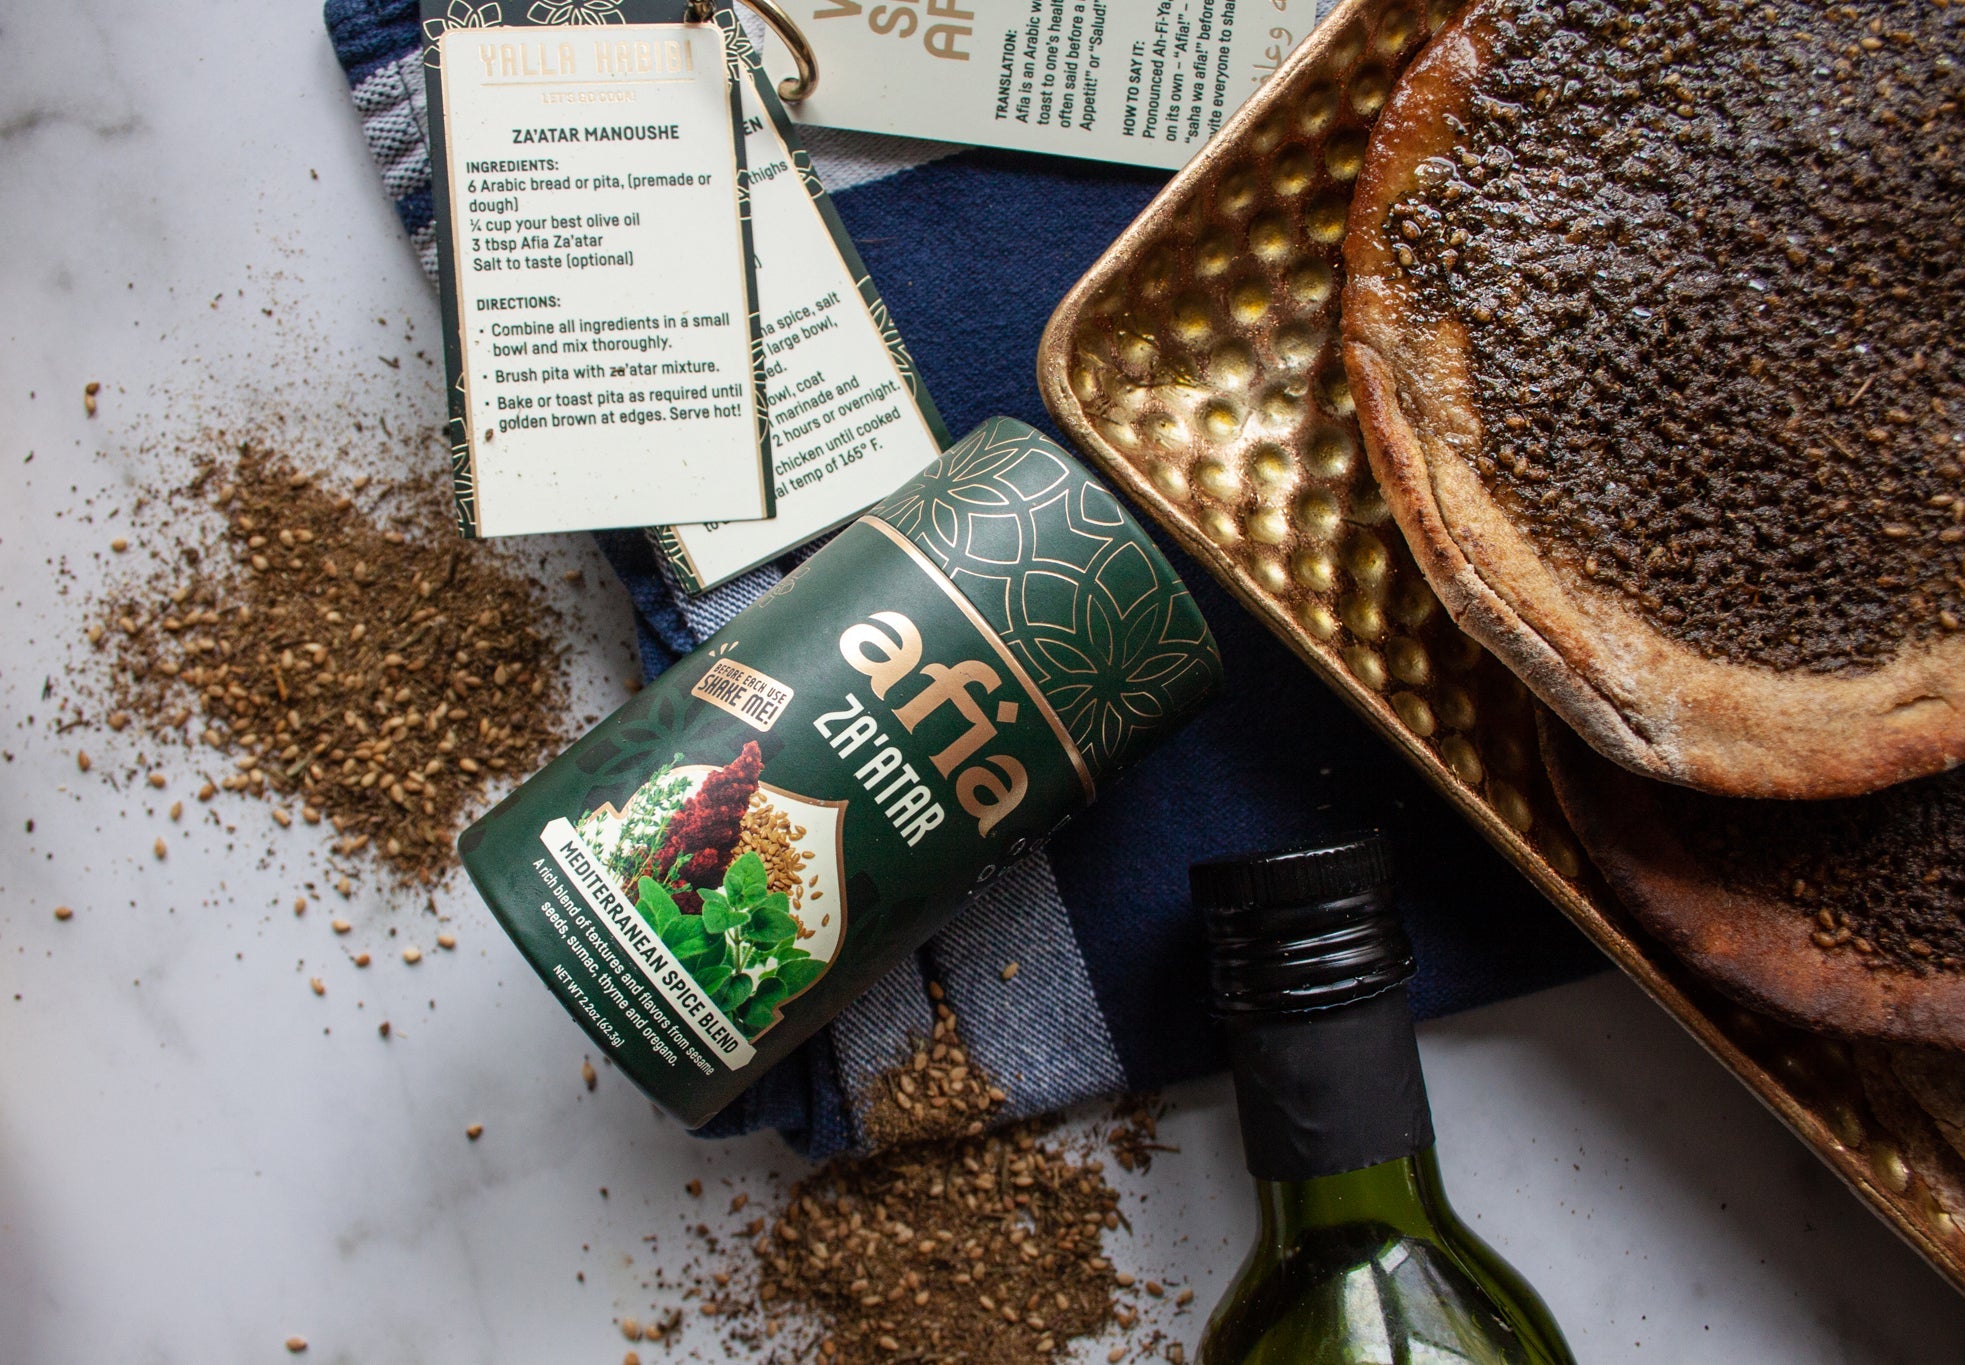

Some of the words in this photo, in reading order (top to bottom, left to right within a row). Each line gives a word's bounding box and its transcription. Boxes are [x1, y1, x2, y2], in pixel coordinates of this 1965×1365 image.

[1074, 5, 1085, 13] a
[1023, 16, 1041, 60] Arabic
[1065, 16, 1084, 59] before
[1132, 40, 1145, 57] IT:
[1218, 29, 1233, 43] to
[478, 42, 576, 77] YALLA
[593, 39, 695, 75] HABIBI
[1045, 35, 1060, 71] one's
[1088, 54, 1100, 69] or
[995, 29, 1017, 120] TRANSLATION:
[1023, 62, 1035, 79] an
[1041, 73, 1055, 88] to
[1063, 61, 1078, 90] said
[1128, 58, 1143, 84] SAY
[1212, 44, 1230, 107] everyone
[1018, 81, 1033, 94] is
[1126, 86, 1140, 102] TO
[1142, 59, 1164, 139] Pronounced
[1170, 73, 1184, 102] own
[1192, 82, 1205, 102] wa
[1015, 96, 1031, 124] Afia
[1036, 90, 1053, 125] toast
[1058, 93, 1075, 128] often
[1122, 104, 1137, 136] HOW
[1165, 105, 1181, 122] its
[512, 127, 580, 144] ZA'ATAR
[584, 125, 680, 142] MANOUSHE
[1166, 125, 1178, 142] on
[466, 158, 559, 174] INGREDIENTS:
[467, 179, 477, 194] 6
[480, 177, 527, 193] Arabic
[530, 176, 571, 191] bread
[575, 178, 589, 190] or
[593, 175, 625, 191] pita,
[698, 174, 712, 186] or
[485, 220, 512, 234] cup
[515, 218, 547, 233] your
[550, 215, 583, 229] best
[586, 213, 620, 228] olive
[623, 212, 640, 227] oil
[472, 238, 481, 252] 3
[485, 237, 517, 253] tbsp
[521, 235, 549, 250] Afia
[553, 234, 604, 249] Za'atar
[473, 257, 502, 272] Salt
[505, 257, 521, 270] to
[524, 255, 562, 270] taste
[476, 295, 561, 311] DIRECTIONS:
[776, 307, 816, 330] spice,
[815, 292, 841, 312] salt
[491, 321, 555, 337] Combine
[559, 319, 576, 334] all
[579, 316, 660, 335] ingredients
[663, 315, 677, 329] in
[680, 317, 689, 328] a
[692, 312, 730, 328] small
[766, 333, 801, 356] large
[800, 315, 838, 340] bowl,
[493, 341, 528, 357] bowl
[532, 340, 558, 355] and
[562, 338, 588, 353] mix
[591, 335, 672, 353] thoroughly.
[495, 367, 538, 384] Brush
[542, 366, 569, 384] pita
[573, 364, 605, 379] with
[661, 360, 720, 375] mixture.
[795, 371, 825, 393] coat
[497, 395, 533, 410] Bake
[537, 396, 552, 408] or
[555, 391, 593, 407] toast
[597, 390, 625, 408] pita
[628, 391, 645, 403] as
[649, 385, 708, 404] required
[711, 383, 743, 399] until
[774, 390, 834, 425] marinade
[835, 375, 860, 396] and
[499, 414, 548, 434] golden
[551, 413, 597, 428] brown
[601, 410, 615, 425] at
[619, 409, 667, 426] edges.
[669, 406, 710, 421] Serve
[713, 403, 741, 418] hot!
[782, 418, 821, 442] hours
[822, 410, 836, 424] or
[837, 380, 901, 417] overnight.
[775, 445, 825, 476] chicken
[825, 428, 855, 452] until
[856, 406, 901, 437] cooked
[789, 468, 824, 491] temp
[825, 457, 839, 474] of
[869, 438, 883, 452] F.
[713, 663, 744, 682] BEFORE
[742, 675, 768, 694] EACH
[766, 687, 787, 704] USE
[697, 674, 748, 708] SHAKE
[740, 693, 779, 726] ME!
[839, 611, 1029, 839] afia
[812, 692, 946, 848] ZA'ATAR
[532, 858, 545, 870] A
[538, 866, 558, 889] rich
[552, 884, 582, 917] blend
[575, 915, 592, 929] of
[559, 840, 669, 973] MEDITERRANEAN
[662, 970, 706, 1017] SPICE
[698, 1011, 739, 1054] BLEND
[585, 926, 625, 975] textures
[541, 901, 569, 939] seeds,
[566, 935, 599, 978] sumac,
[598, 973, 629, 1010] thyme
[625, 1008, 649, 1029] and
[642, 1027, 678, 1067] oregano.
[553, 964, 573, 984] NET
[567, 980, 585, 998] WT
[578, 996, 601, 1021] 2.2oz
[621, 973, 645, 995] and
[638, 992, 671, 1029] flavors
[667, 1025, 690, 1050] from
[685, 1047, 715, 1076] sesame
